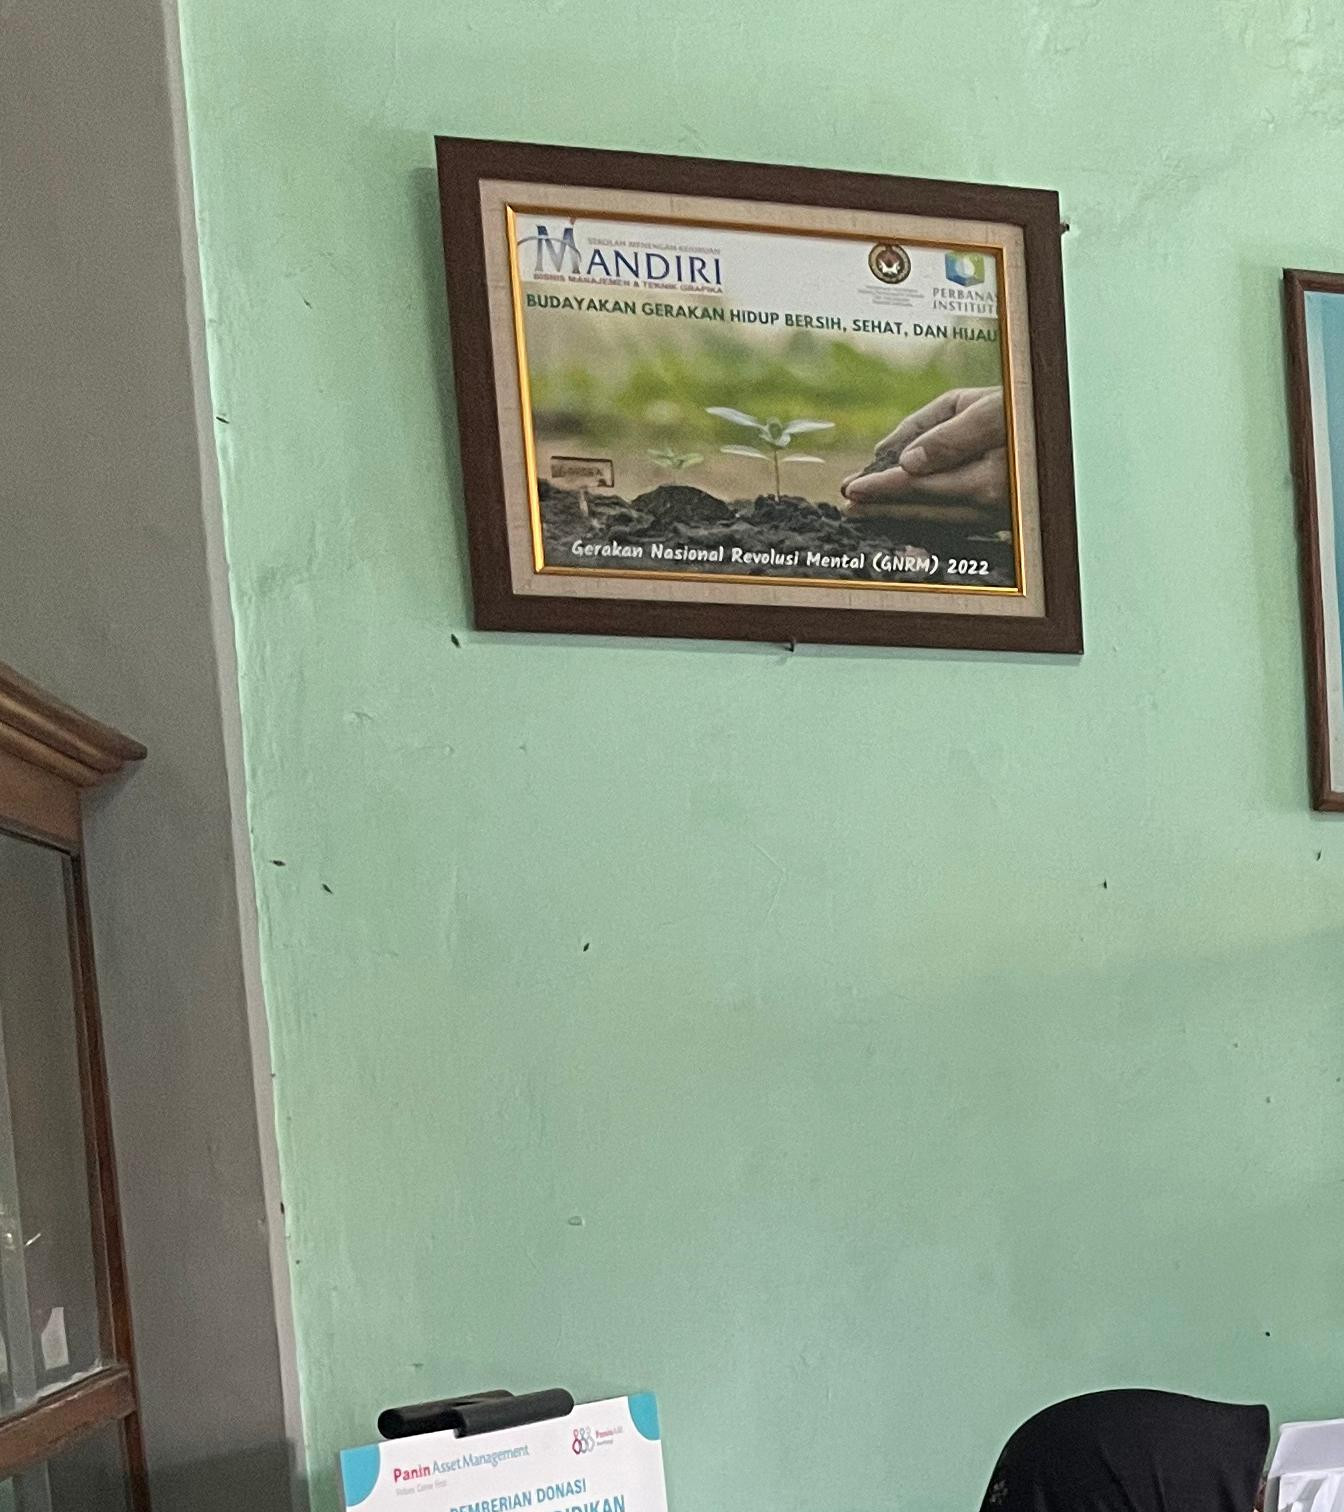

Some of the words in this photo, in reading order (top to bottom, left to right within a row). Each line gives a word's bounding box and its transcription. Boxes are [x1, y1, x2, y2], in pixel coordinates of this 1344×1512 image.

[534, 225, 723, 285] MANDIRI
[933, 287, 998, 302] PERBANA
[527, 294, 636, 315] BUDAYAKAN
[641, 302, 725, 322] GERAKAN
[730, 309, 780, 325] HIDUP
[785, 313, 847, 333] BERSIH,
[852, 318, 909, 337] SEHAT,
[913, 323, 948, 339] DAN
[952, 326, 998, 342] HIJAU
[571, 540, 643, 559] Gerakan
[651, 544, 724, 562] Nasional
[731, 547, 799, 566] Revolusi
[806, 551, 865, 569] Mental
[872, 551, 939, 576] (GNRM)
[947, 559, 990, 576] 2022
[393, 1464, 431, 1483] Panin
[432, 1459, 463, 1475] Asset
[462, 1444, 530, 1469] Management
[536, 1478, 587, 1503] DONASI
